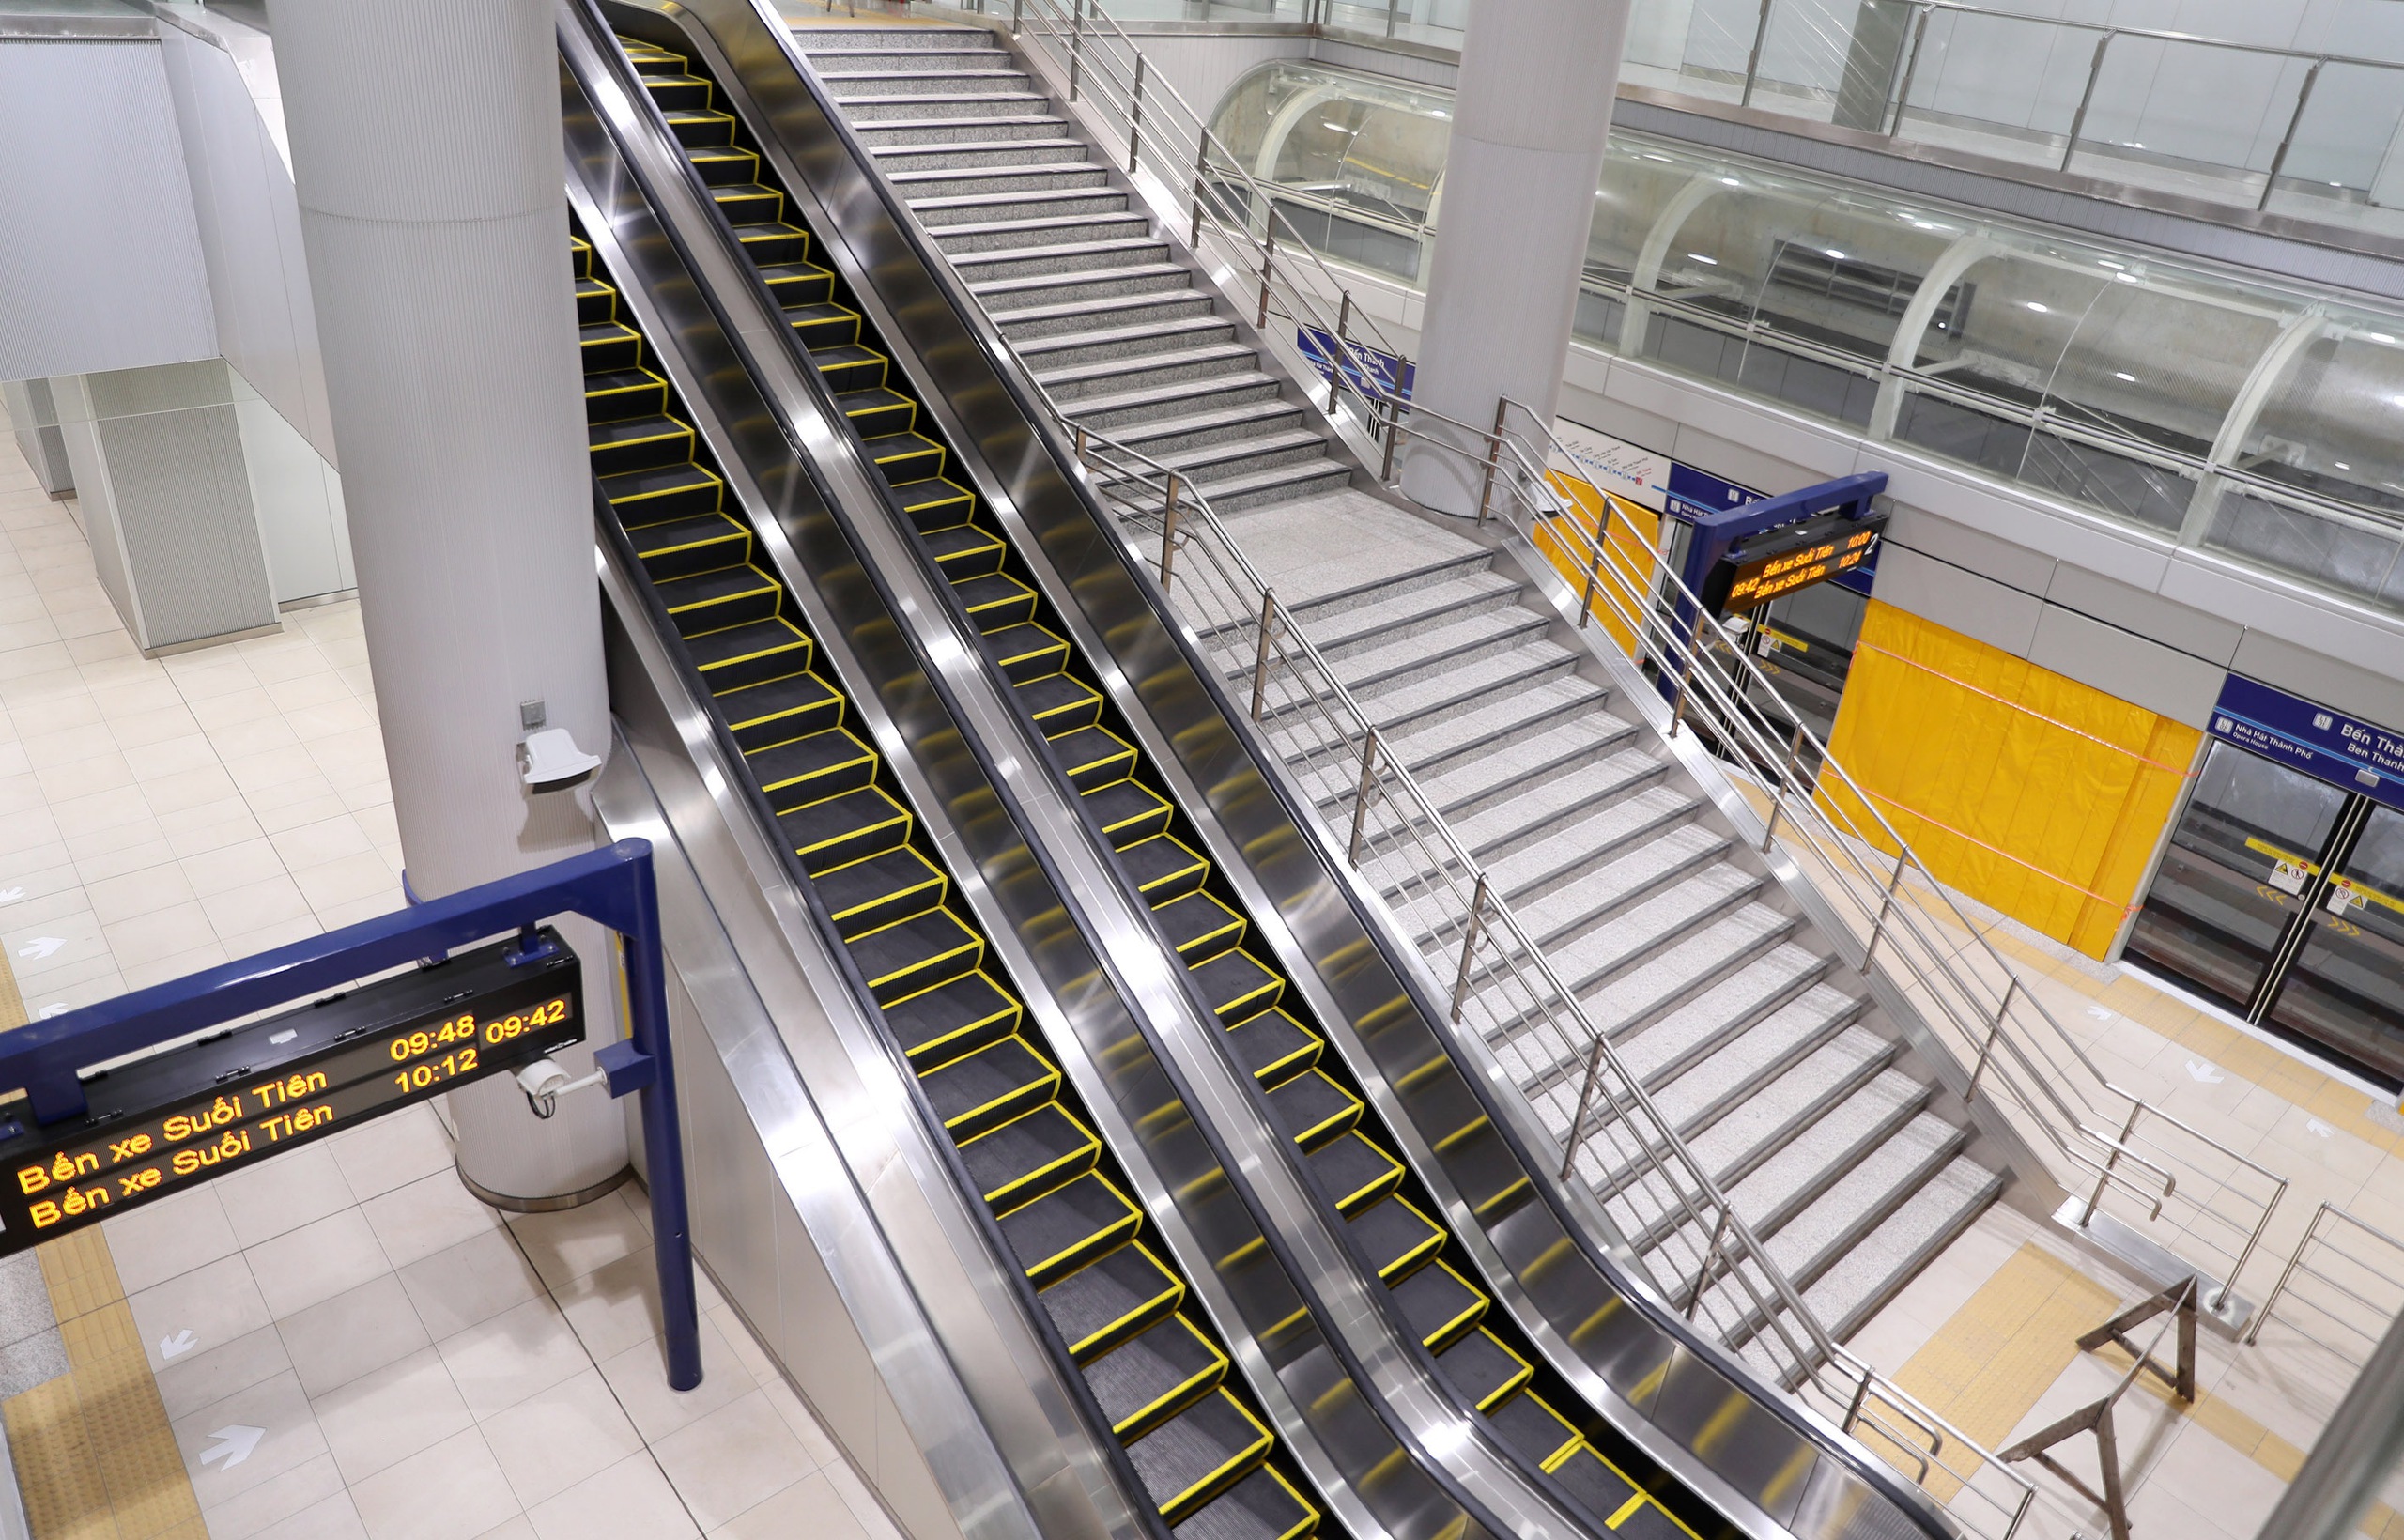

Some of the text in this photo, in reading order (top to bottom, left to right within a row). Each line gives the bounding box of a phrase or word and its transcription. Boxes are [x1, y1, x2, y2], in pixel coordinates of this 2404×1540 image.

[1847, 531, 1872, 549] 10:00
[1864, 533, 1879, 555] 2
[1839, 550, 1863, 569] 10:24
[1731, 578, 1761, 598] 09:42
[2232, 732, 2269, 750] Opera House
[2235, 723, 2252, 736] Nhà
[2269, 736, 2293, 752] Thành
[2294, 747, 2314, 760] Phố
[2340, 723, 2404, 759] Bến Thà
[2347, 742, 2368, 758] Ben
[390, 1014, 476, 1061] 09:48
[485, 999, 566, 1044] 09:42
[394, 1047, 479, 1093] 10:12
[17, 1070, 328, 1195] Bến xe Suối Tiên
[29, 1186, 110, 1229] Bến
[118, 1167, 162, 1197] xe
[172, 1129, 252, 1176] Suối
[258, 1104, 334, 1141] Tiên
